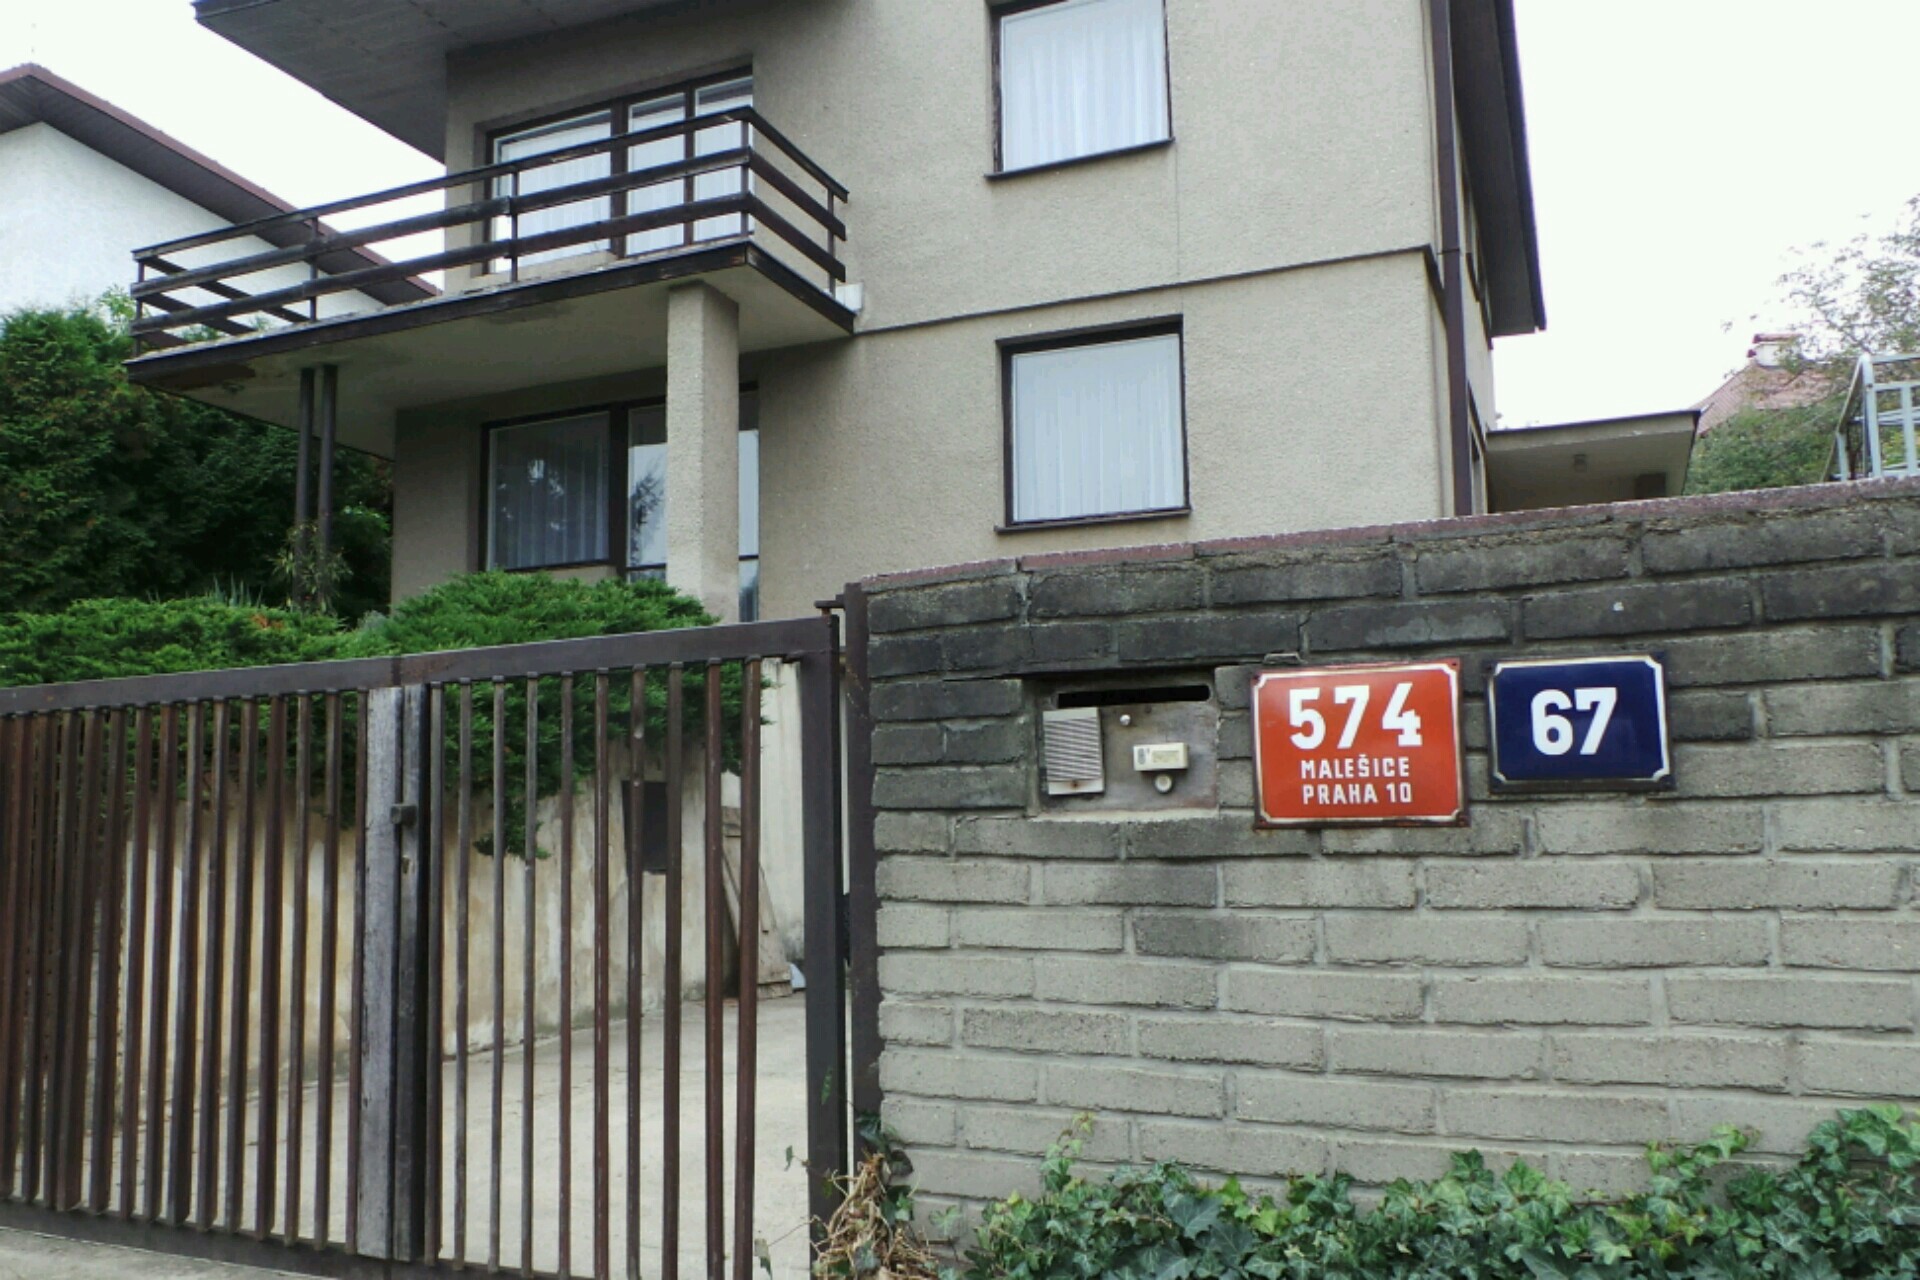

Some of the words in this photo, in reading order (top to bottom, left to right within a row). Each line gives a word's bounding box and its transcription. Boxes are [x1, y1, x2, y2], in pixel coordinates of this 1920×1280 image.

[1289, 683, 1423, 750] 574
[1530, 686, 1618, 756] 67
[1301, 753, 1410, 779] MALEŠICE
[1303, 784, 1377, 805] PRAHA
[1386, 781, 1412, 803] 10
